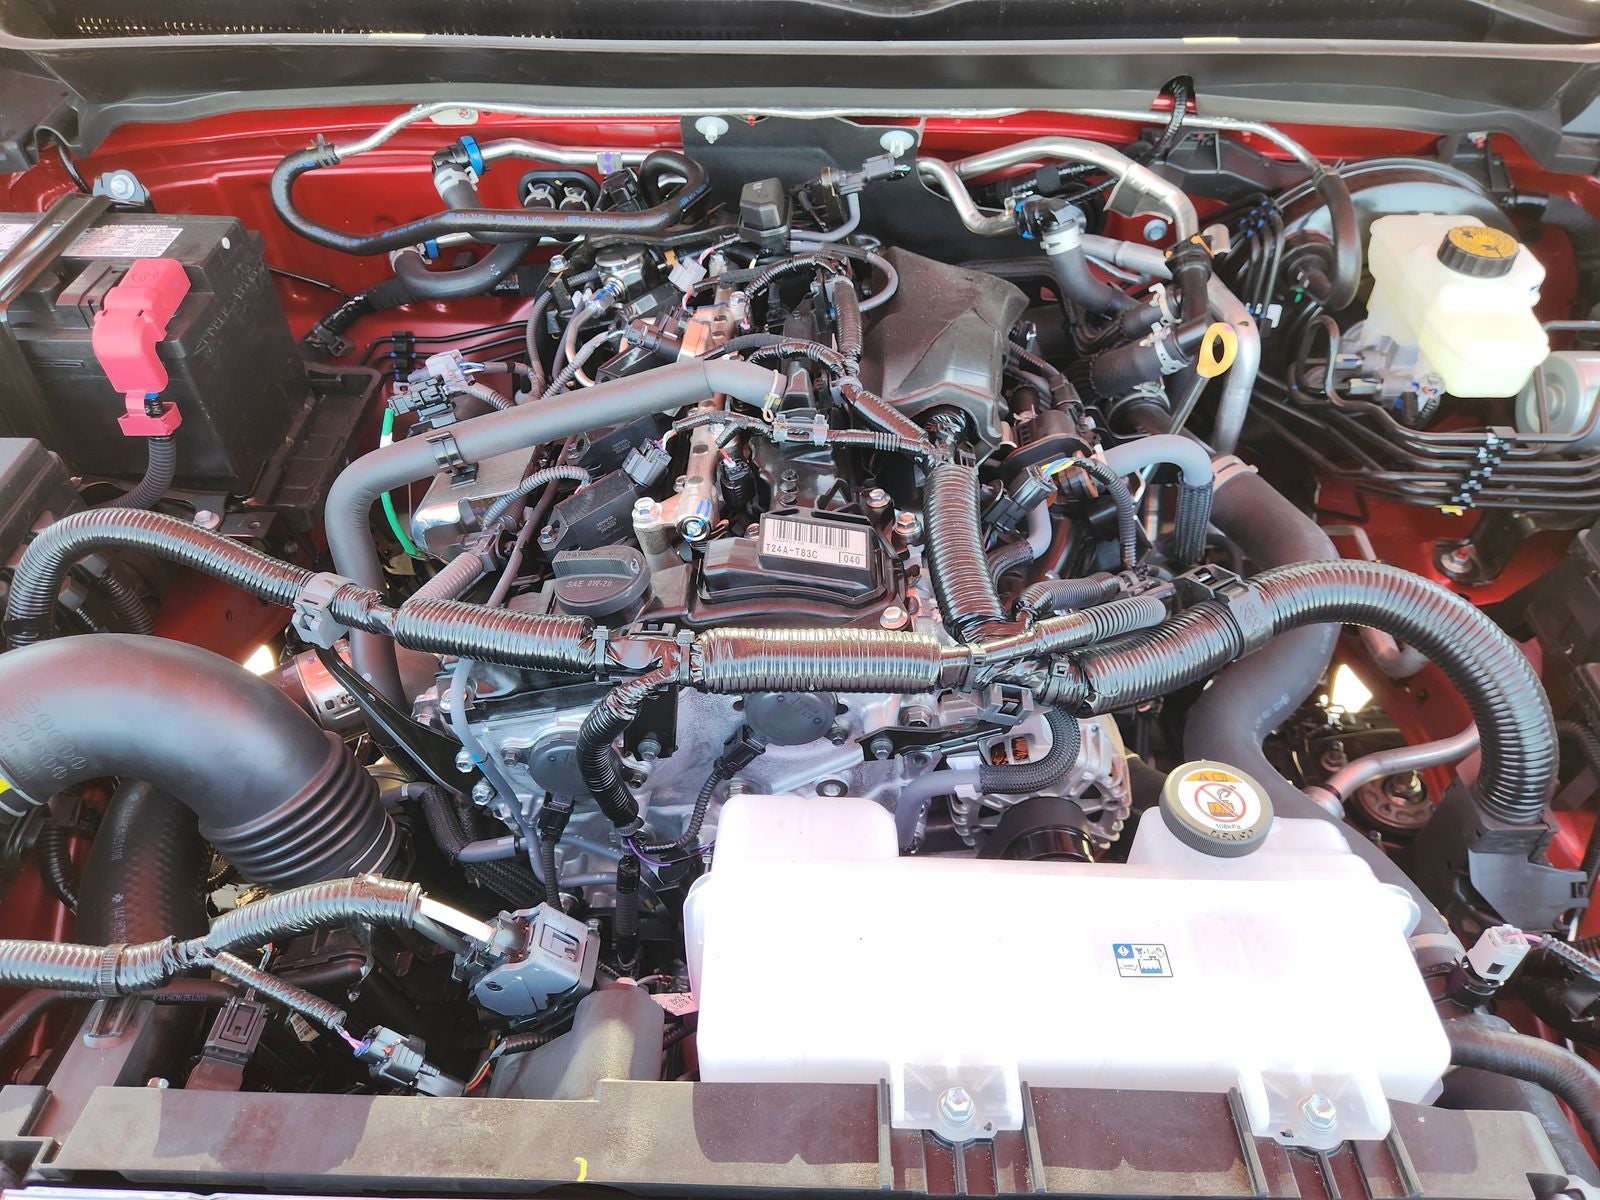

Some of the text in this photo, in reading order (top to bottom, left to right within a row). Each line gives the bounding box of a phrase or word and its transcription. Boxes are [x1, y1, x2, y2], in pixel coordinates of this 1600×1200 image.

[765, 543, 818, 559] T24A-T83C
[843, 554, 861, 565] 040
[566, 580, 584, 588] SAE
